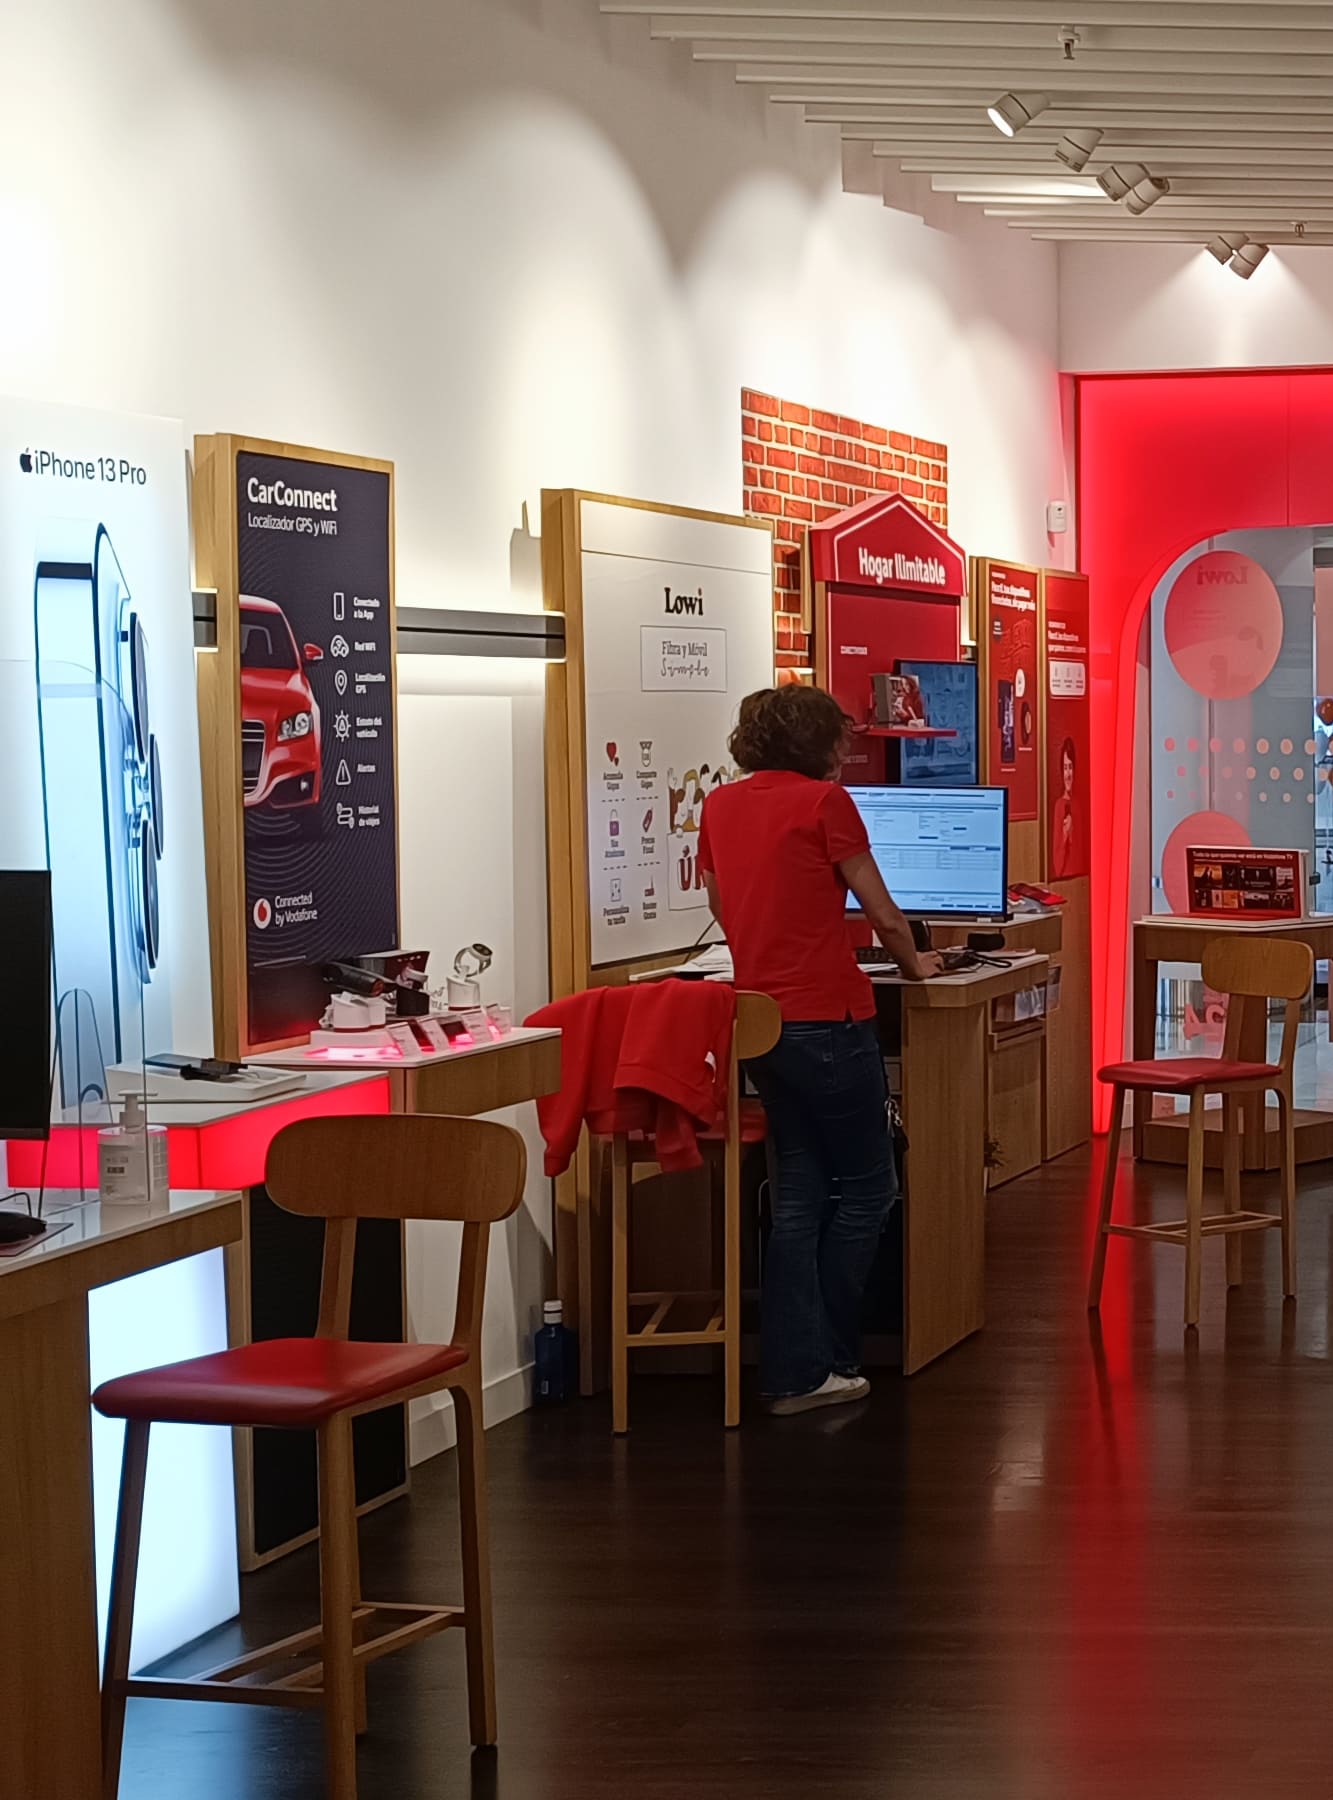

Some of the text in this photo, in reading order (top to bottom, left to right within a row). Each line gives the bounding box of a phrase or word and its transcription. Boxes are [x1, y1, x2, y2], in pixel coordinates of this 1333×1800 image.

[34, 450, 147, 485] iPhone 13 Pro
[247, 477, 338, 512] CarConnect
[248, 512, 294, 531] Localizador
[295, 517, 313, 533] GPS
[313, 522, 320, 537] y
[858, 546, 946, 587] Hogar Ilimitable
[663, 587, 704, 616] Lowi
[275, 891, 313, 909] Connected
[275, 908, 318, 928] by Vodafone
